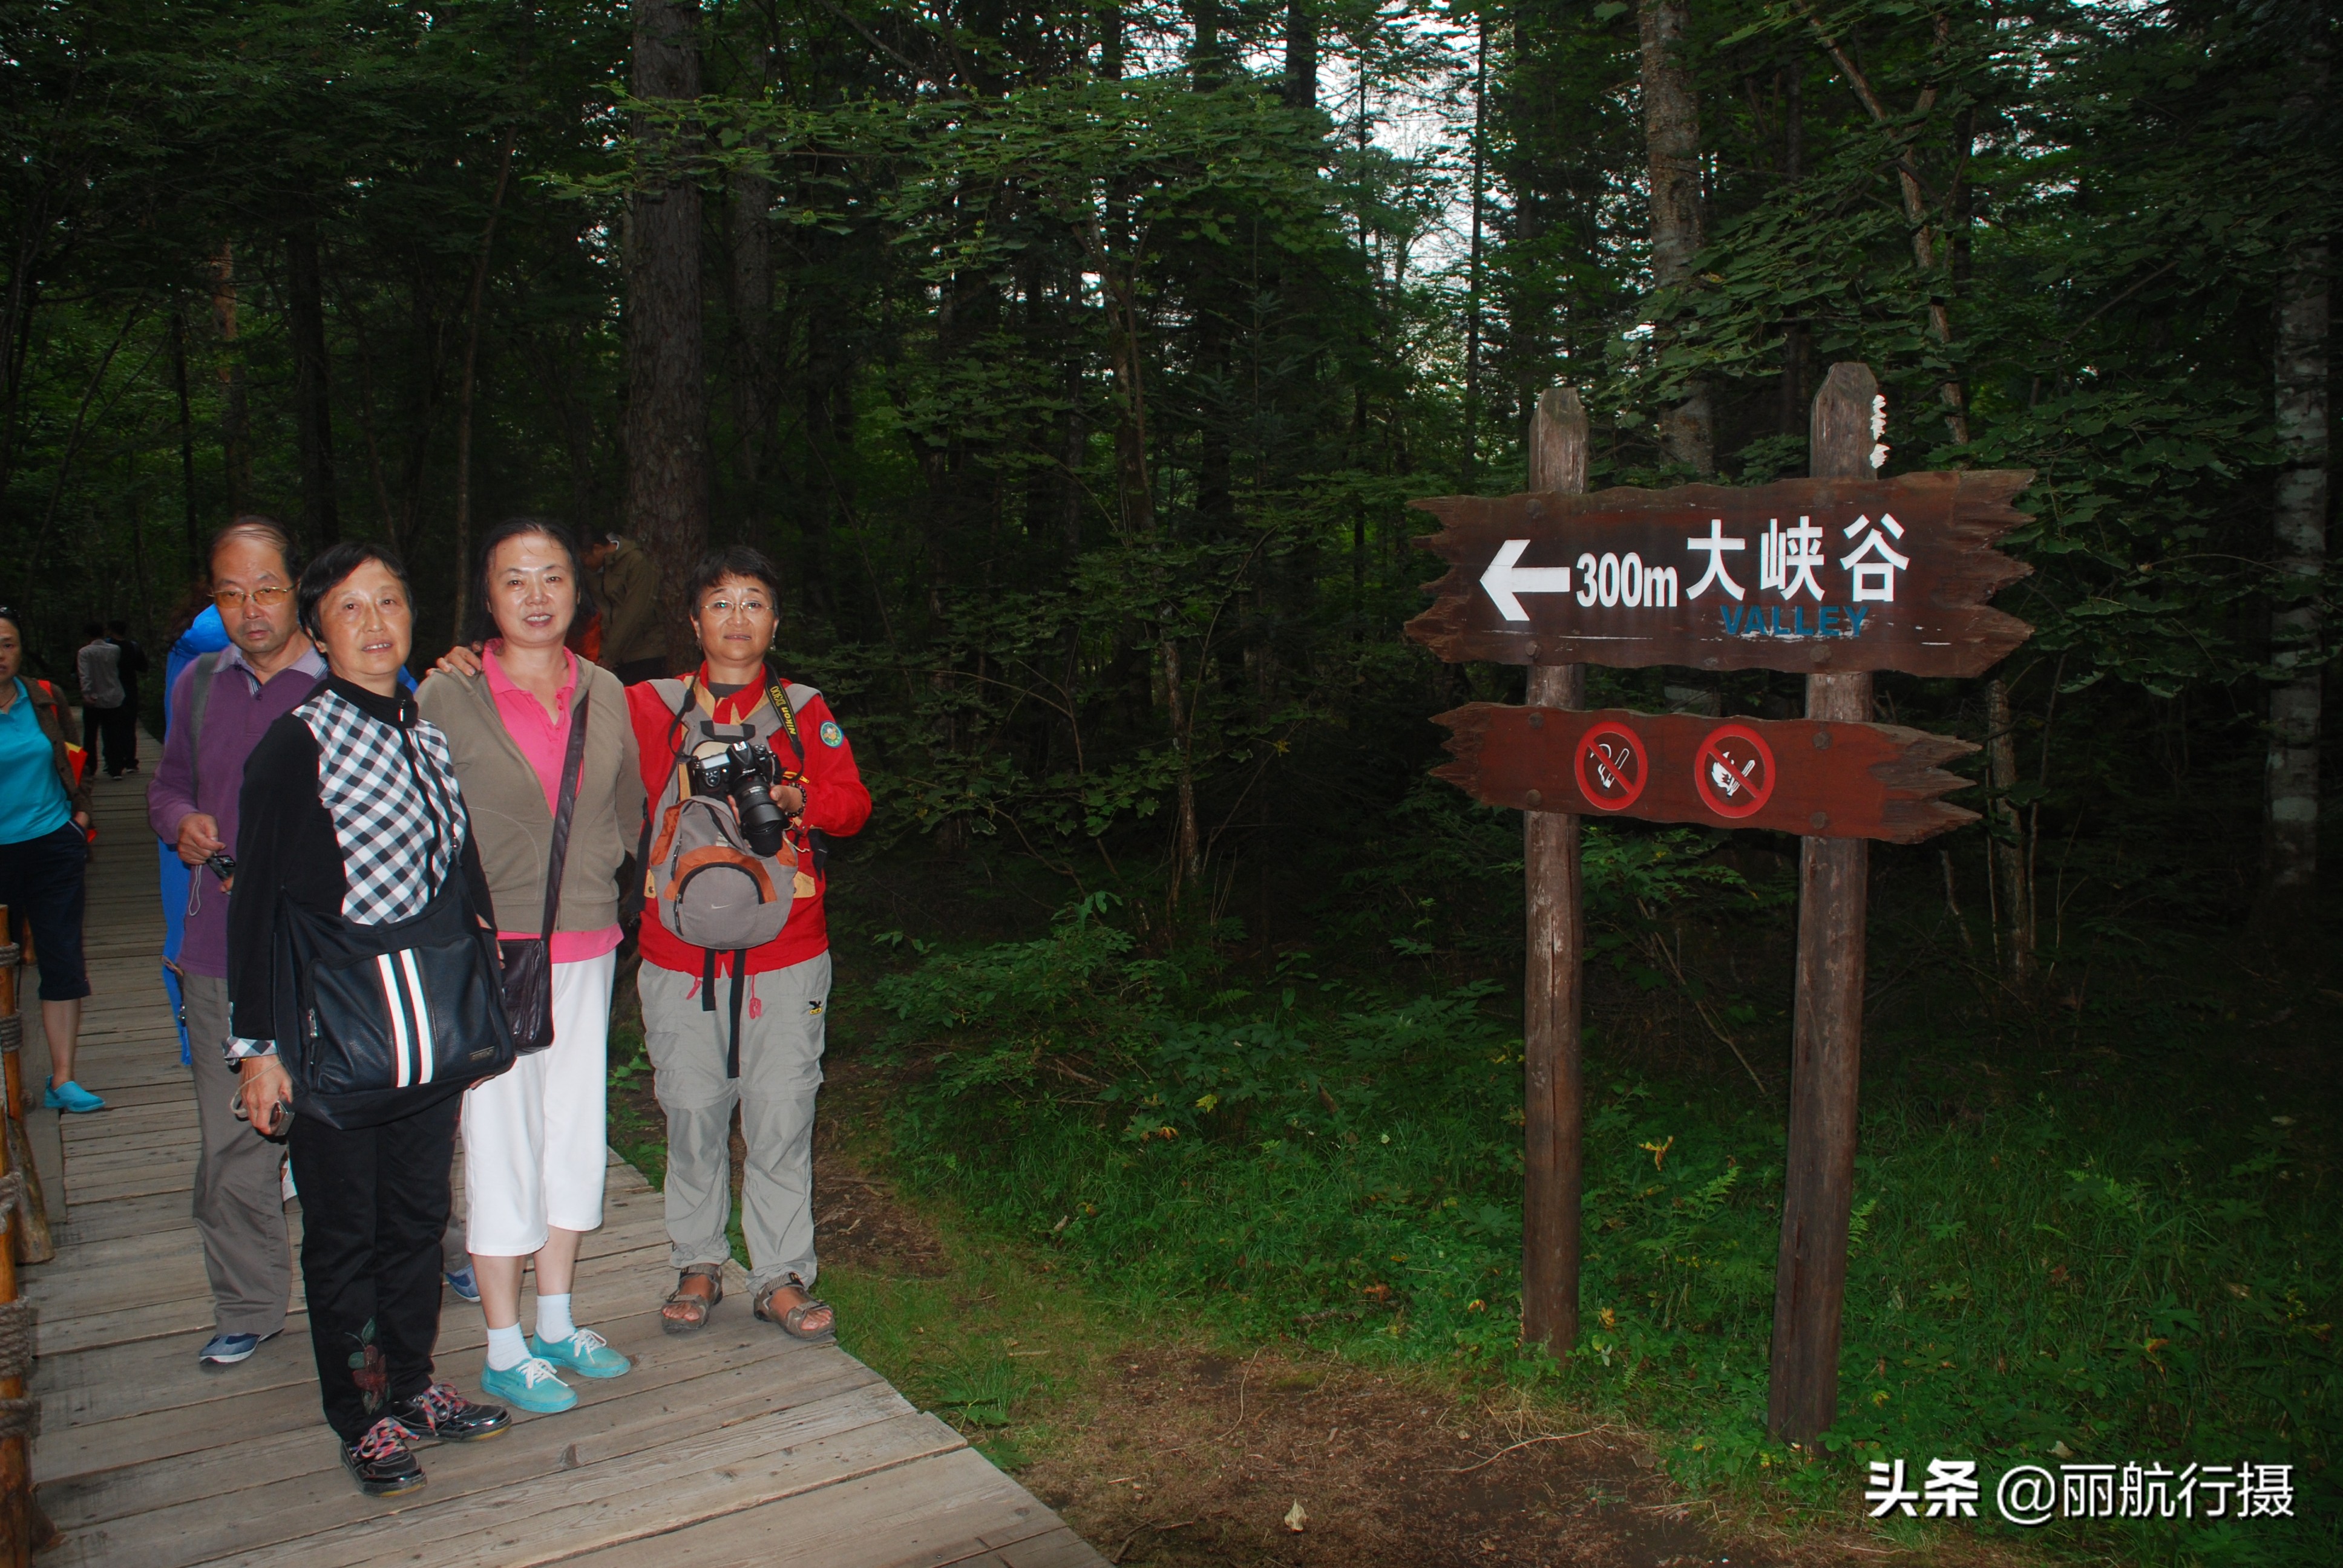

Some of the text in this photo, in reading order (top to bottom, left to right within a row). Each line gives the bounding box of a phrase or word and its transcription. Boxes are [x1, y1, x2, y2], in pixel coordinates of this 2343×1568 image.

[1576, 513, 1910, 607] 300m 大峡谷
[1720, 605, 1869, 638] VALLEY
[770, 685, 797, 735] Nikon D300
